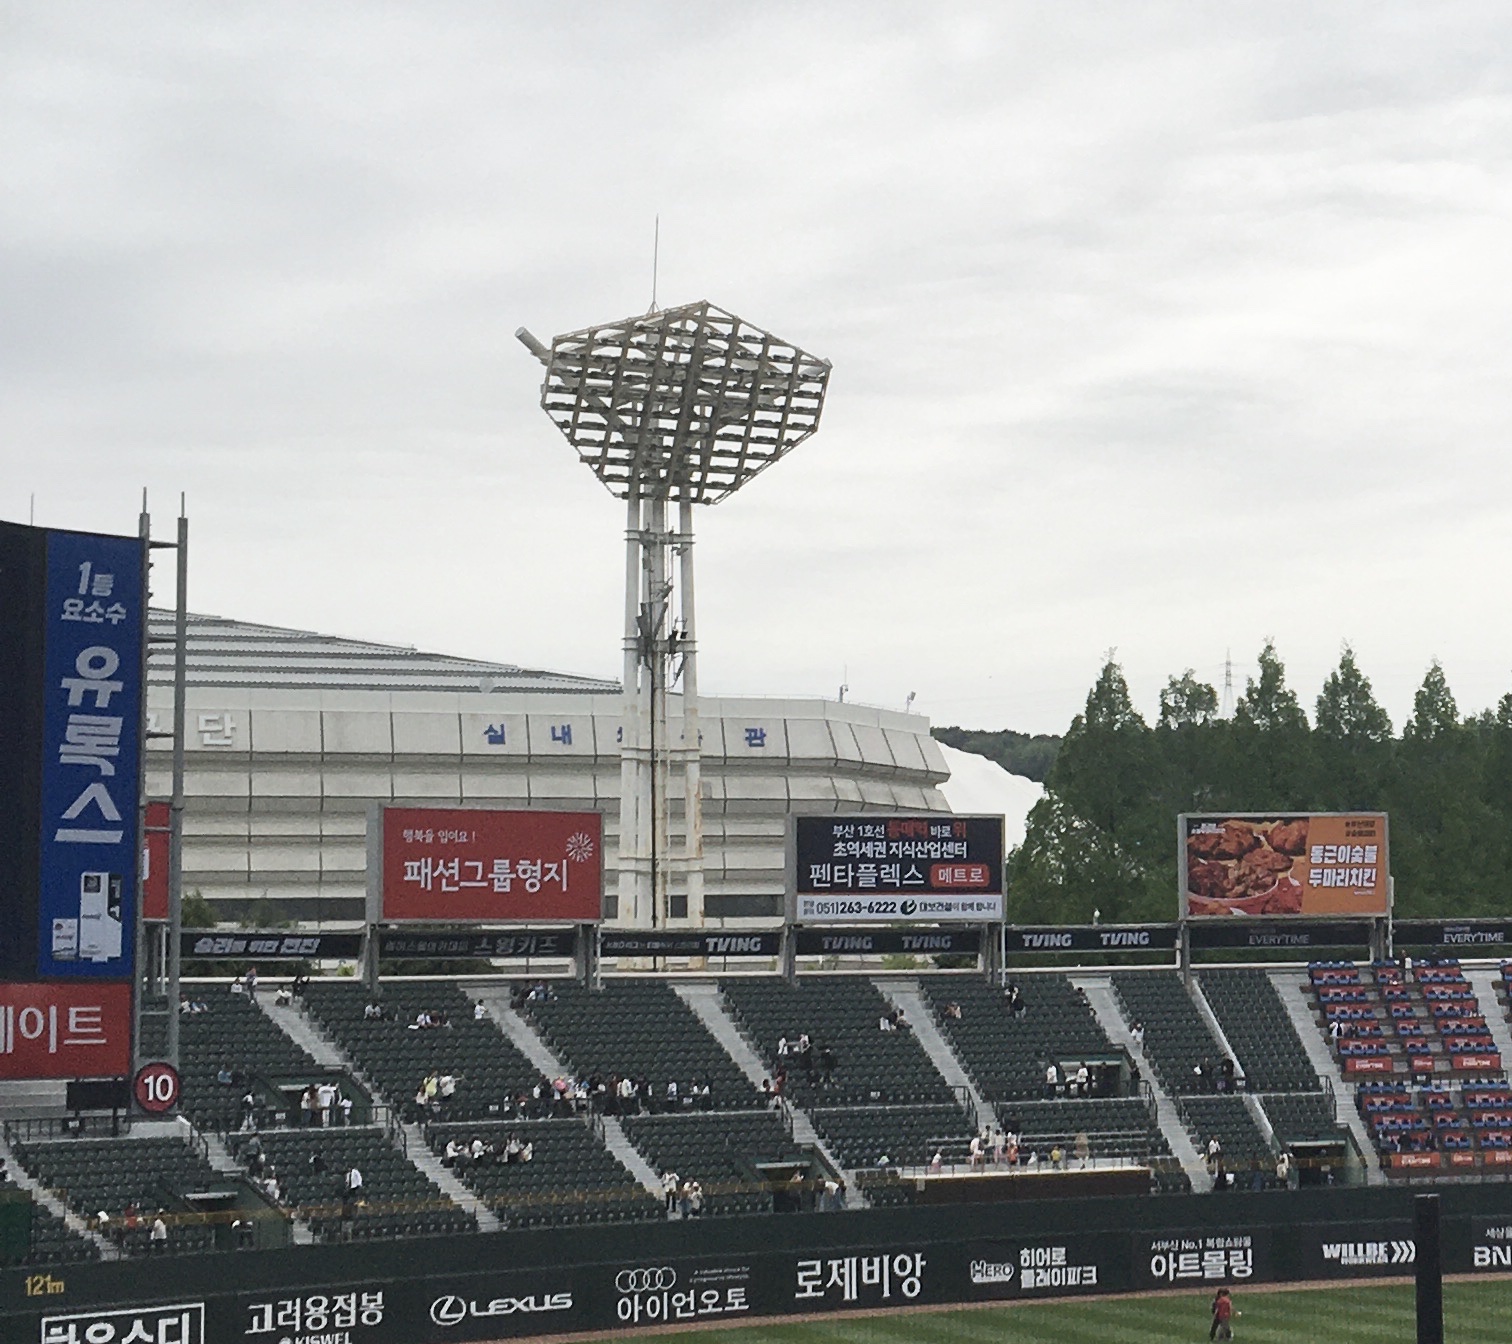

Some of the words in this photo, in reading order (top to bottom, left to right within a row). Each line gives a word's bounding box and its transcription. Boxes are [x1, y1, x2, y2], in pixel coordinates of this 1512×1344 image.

[61, 598, 127, 625] 요소수
[54, 645, 124, 844] 유록스
[438, 829, 468, 844] 입어요
[832, 825, 855, 838] 부산
[857, 824, 885, 838] 1호선
[931, 824, 953, 839] 바로
[954, 821, 967, 838] 위
[833, 841, 887, 859] 초역세권
[889, 841, 968, 859] 지식산업센터
[403, 857, 568, 893] 패션그룹형지
[809, 863, 925, 888] 펜타플렉스
[938, 868, 985, 883] 메트로
[1308, 868, 1377, 887] 두마리치킨
[816, 901, 897, 915] 051)263-6222
[705, 937, 762, 952] TVING
[822, 936, 873, 950] TVING
[901, 935, 952, 949] TVING
[1022, 934, 1073, 947] TVING
[1100, 932, 1151, 946] TVING
[143, 1074, 174, 1102] 10
[1181, 1238, 1203, 1250] No.1
[1322, 1242, 1389, 1259] WILLBE
[1019, 1247, 1067, 1267] 히어로
[1150, 1248, 1253, 1281] 아트몰링
[795, 1252, 927, 1301] 로제비앙
[971, 1260, 1015, 1283] HERO
[25, 1275, 65, 1297] 121m
[244, 1290, 385, 1335] 고려용접봉
[470, 1293, 573, 1316] LEXUS
[616, 1287, 750, 1323] 아이언오토
